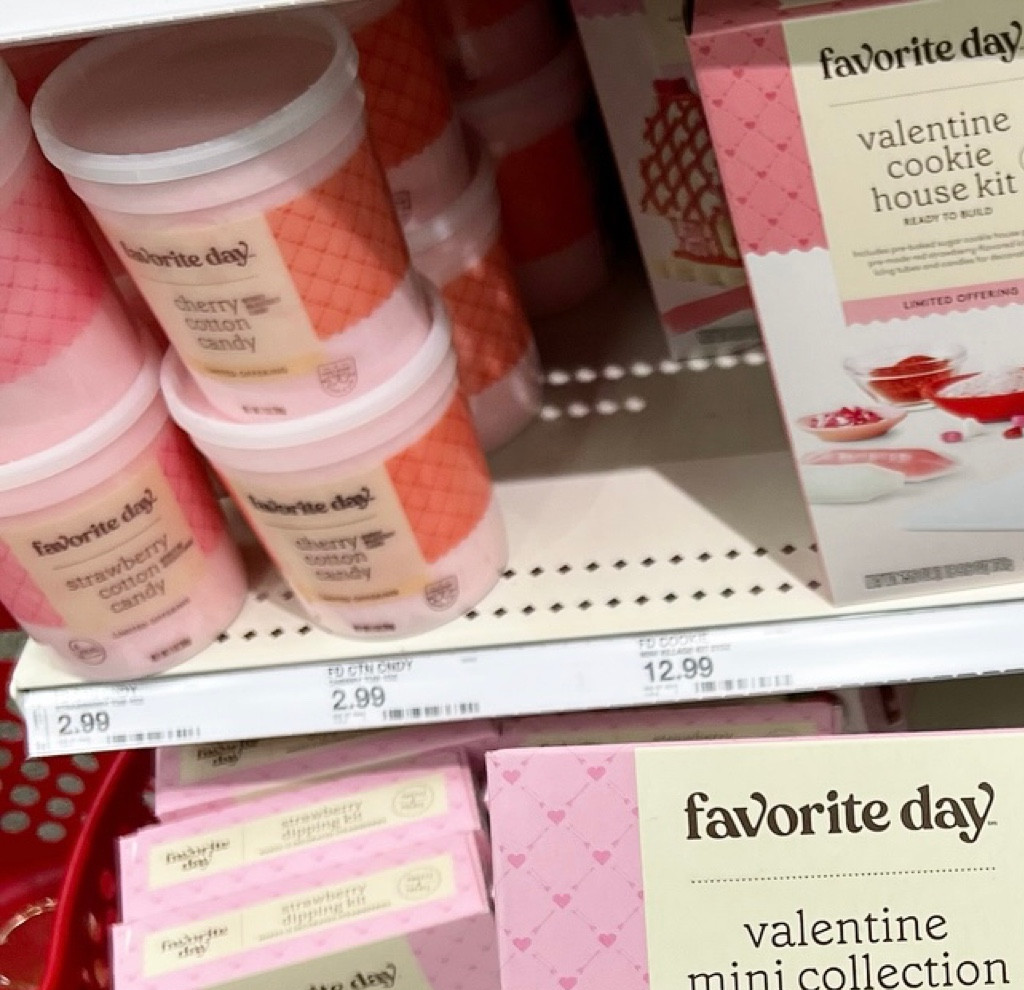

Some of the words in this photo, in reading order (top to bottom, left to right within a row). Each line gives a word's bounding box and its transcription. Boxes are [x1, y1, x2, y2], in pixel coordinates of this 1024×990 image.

[819, 37, 956, 80] favorite
[961, 20, 1023, 63] day
[858, 111, 1012, 151] valentine
[887, 144, 994, 180] cookie
[872, 182, 970, 213] house
[976, 172, 1019, 199] kit
[904, 215, 940, 226] READY
[943, 211, 957, 221] TO
[960, 207, 994, 219] BUILD
[205, 241, 250, 267] day
[903, 296, 953, 310] LIMITED
[957, 287, 1019, 304] OFFERING
[32, 517, 120, 557] favorite
[120, 488, 158, 524] day
[66, 534, 170, 592] strawberry
[99, 565, 161, 600] cotton
[109, 579, 167, 614] candy
[643, 656, 714, 683] 12.99
[332, 686, 386, 711] 2.99
[58, 712, 110, 735] 2.99
[684, 789, 891, 840] favorite
[900, 781, 995, 844] day
[743, 907, 949, 948] valentine
[350, 962, 398, 990] day
